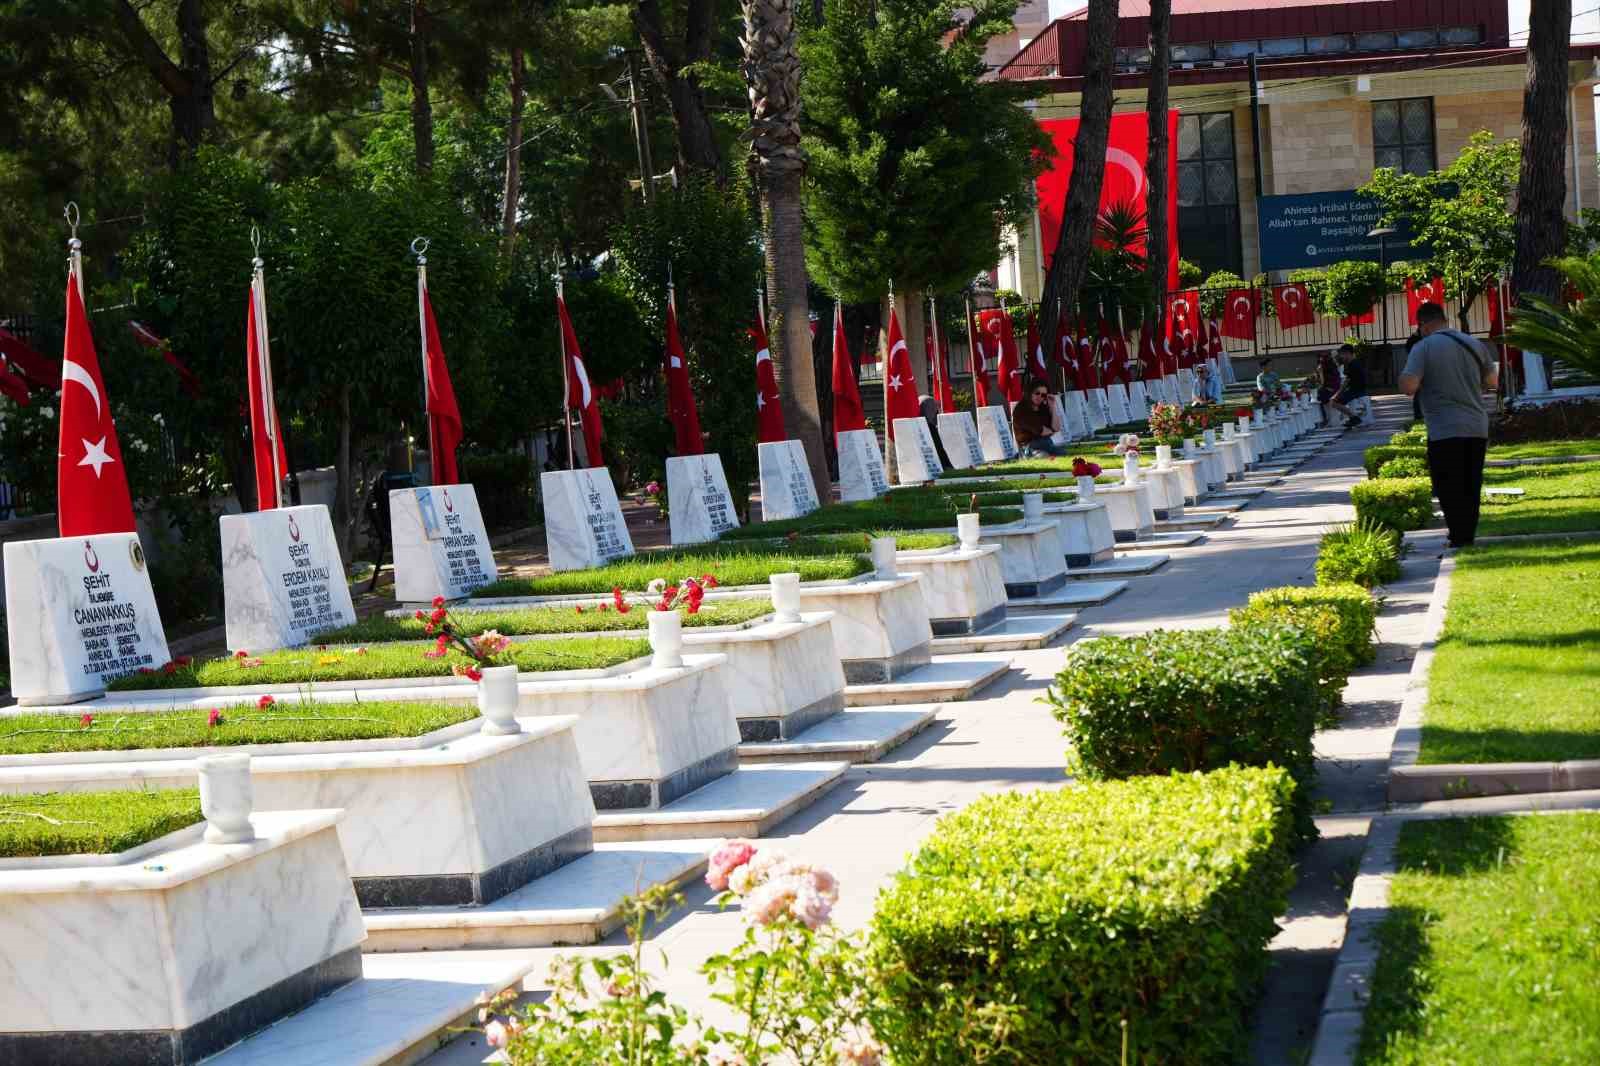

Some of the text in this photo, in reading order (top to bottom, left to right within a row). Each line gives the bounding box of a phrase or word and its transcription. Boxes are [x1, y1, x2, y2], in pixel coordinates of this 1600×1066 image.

[1350, 201, 1372, 210] Eden
[83, 570, 111, 593] ŞEHİT
[282, 570, 307, 587] ERDEM
